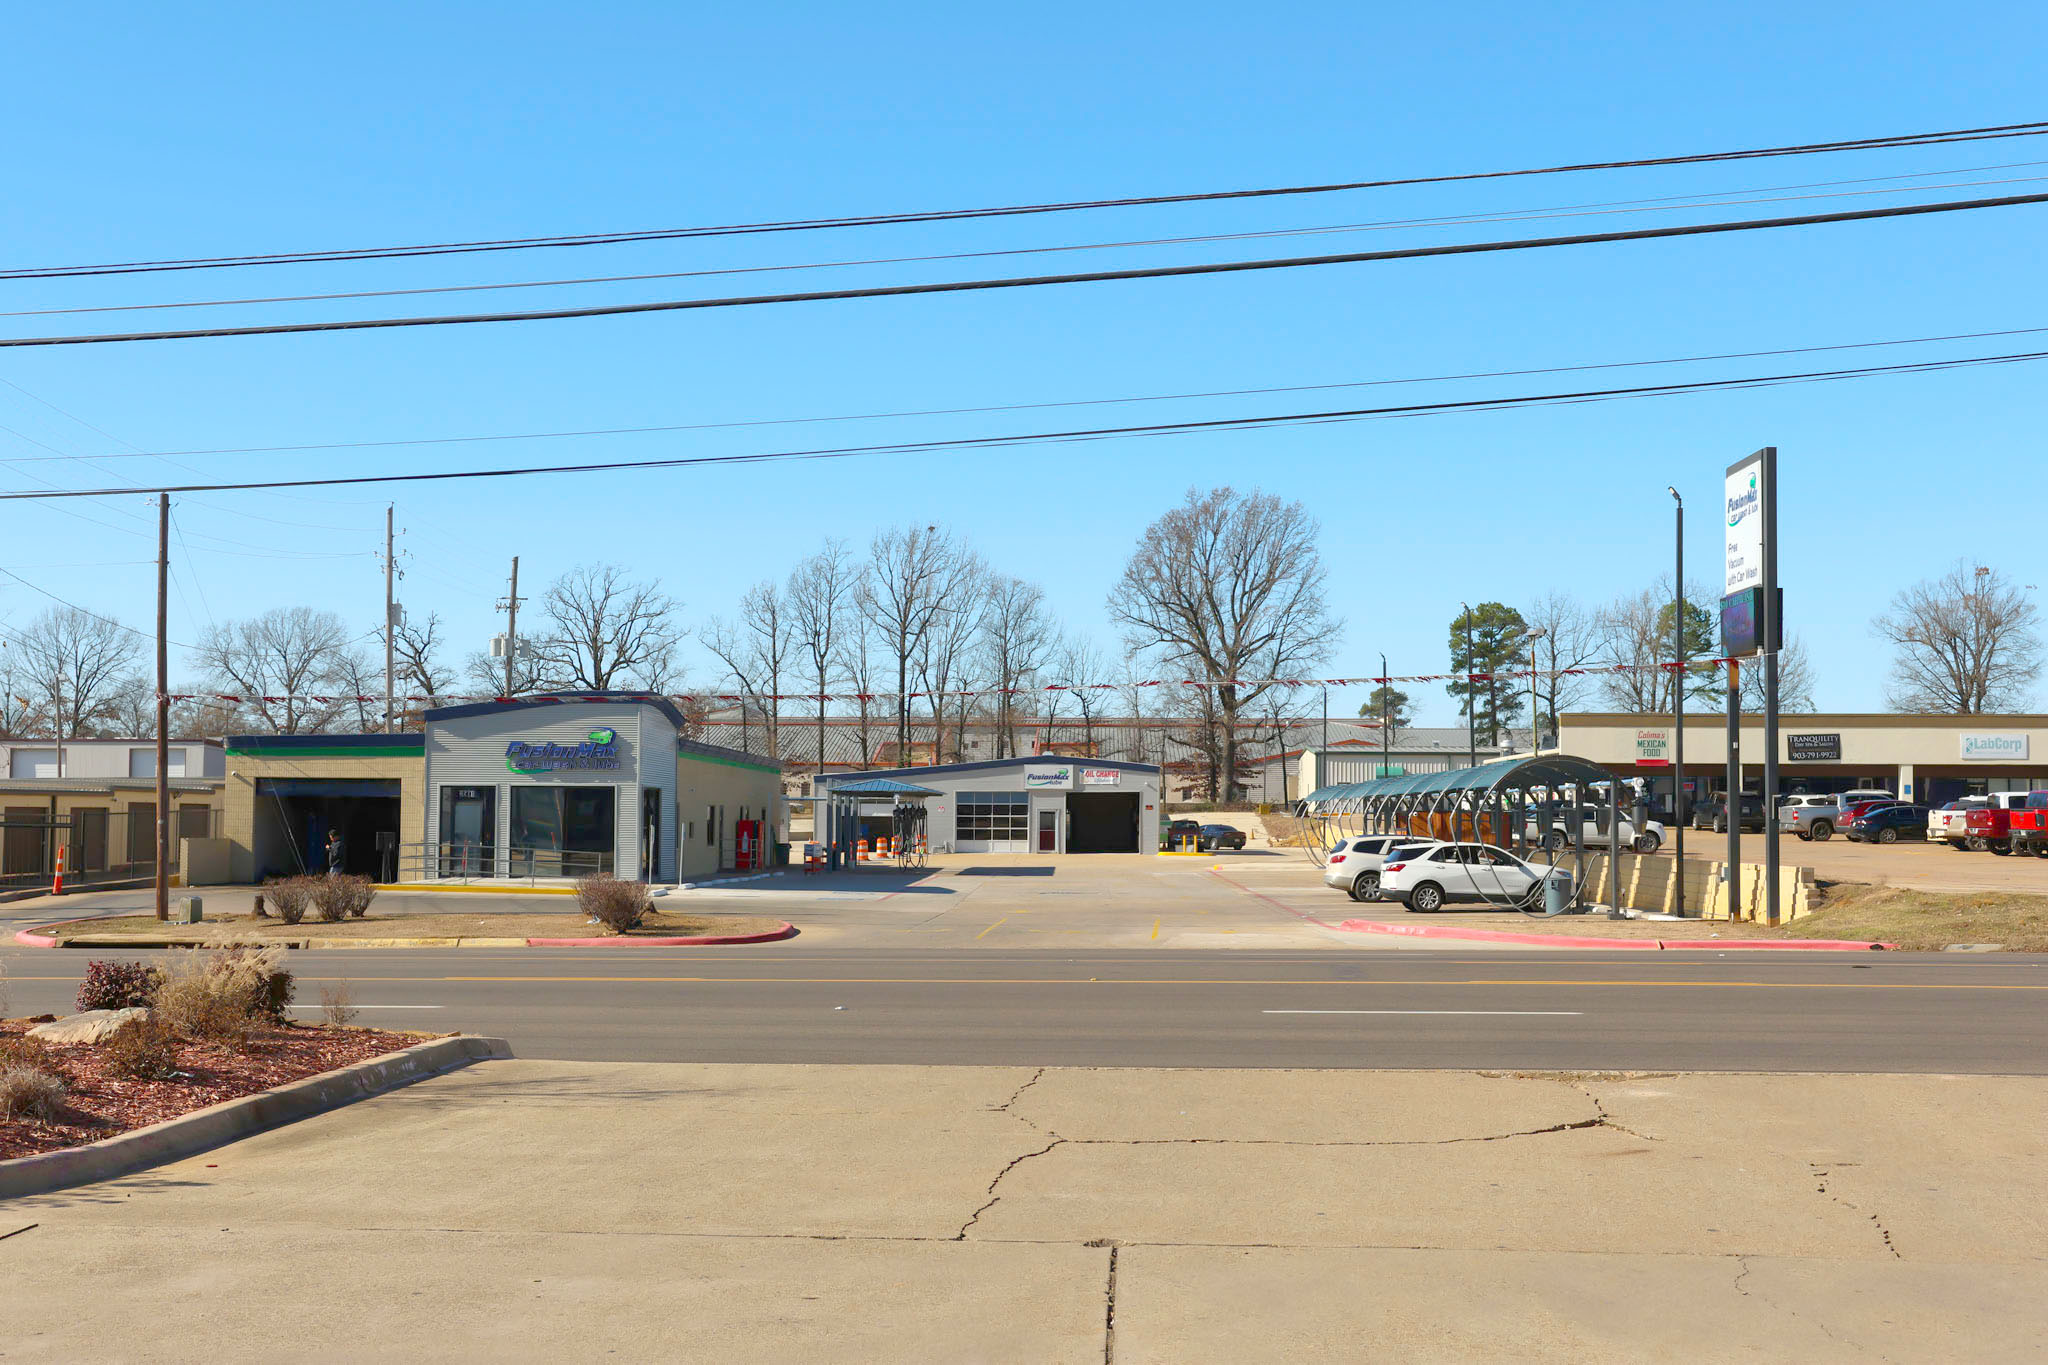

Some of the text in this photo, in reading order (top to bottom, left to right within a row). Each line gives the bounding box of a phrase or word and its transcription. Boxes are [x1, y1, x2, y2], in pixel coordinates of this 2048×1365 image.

[1728, 543, 1738, 554] Free
[1788, 735, 1839, 743] TRANQUILITY
[1637, 740, 1666, 748] MEXICAN
[1974, 737, 2022, 752] LabCorp
[505, 741, 617, 758] FusionMax
[1643, 749, 1661, 757] FOOD
[1792, 752, 1837, 760] 903-791-9922
[1085, 770, 1120, 778] OIL CHANGE
